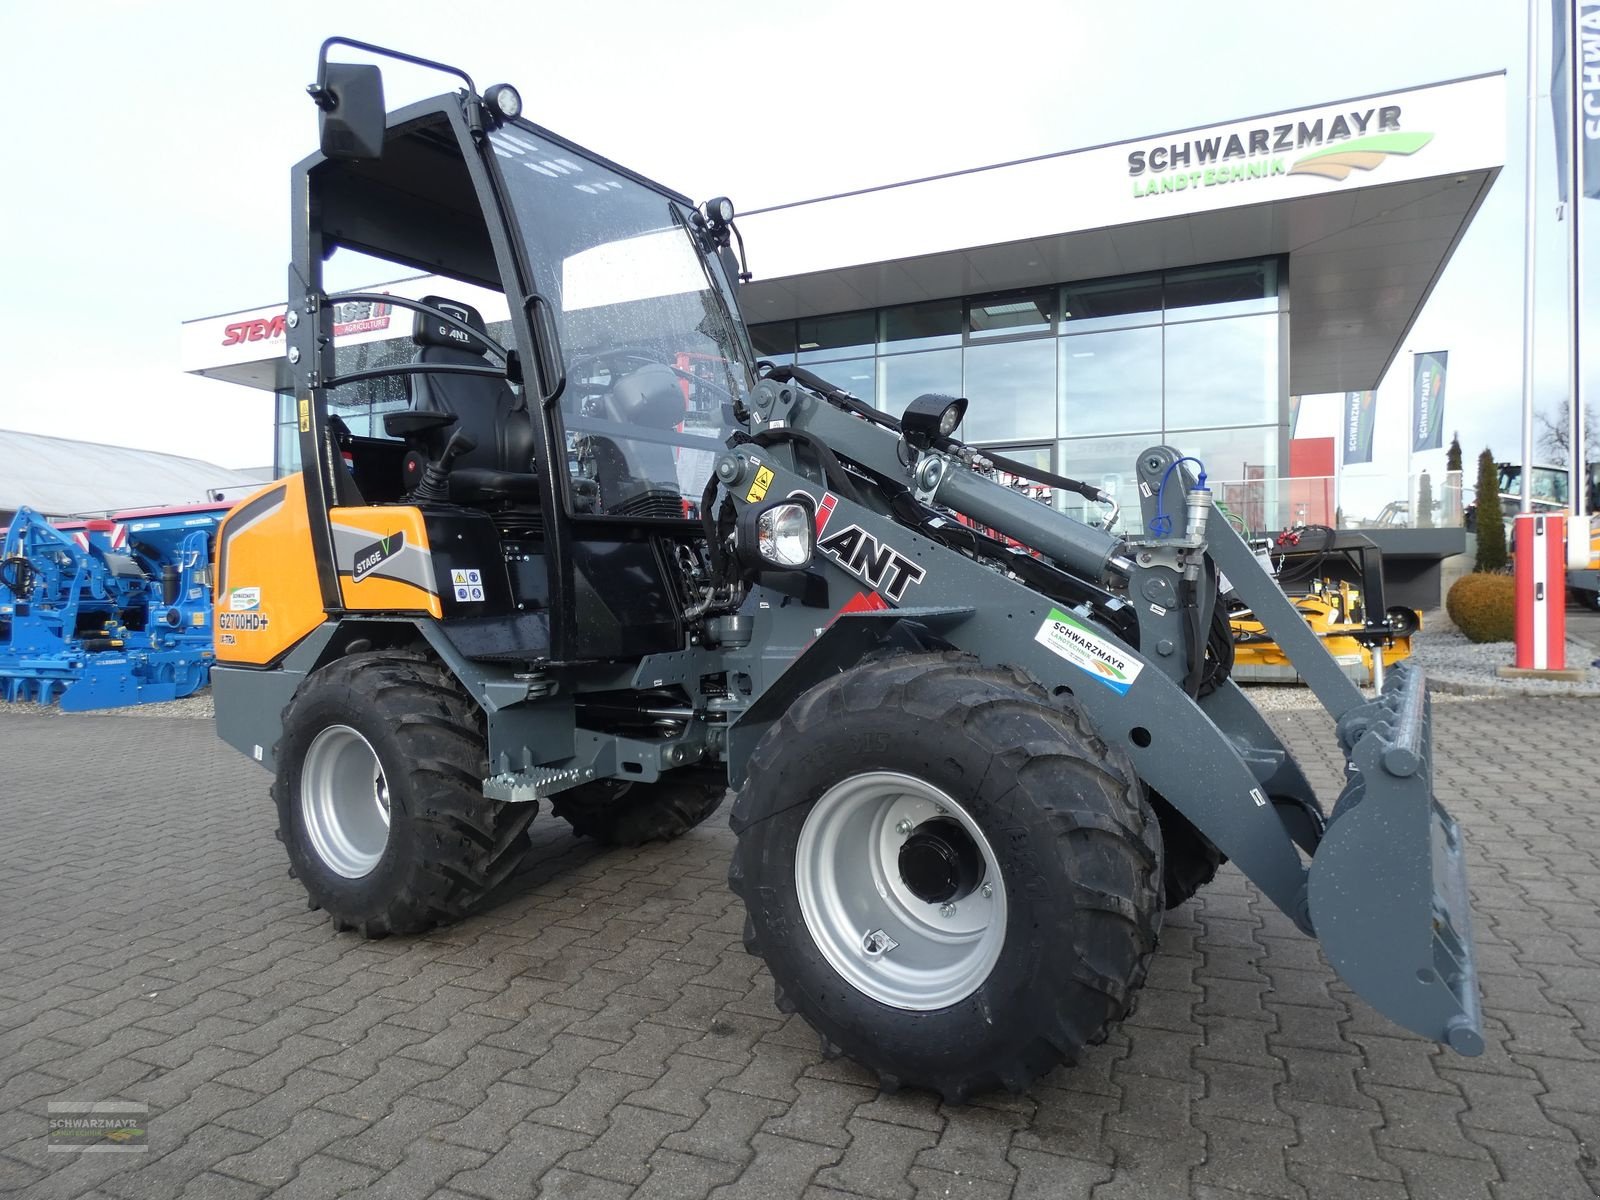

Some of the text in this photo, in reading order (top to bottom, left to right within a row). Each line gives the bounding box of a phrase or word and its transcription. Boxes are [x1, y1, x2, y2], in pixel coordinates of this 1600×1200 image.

[1581, 0, 1600, 140] SCHWA
[1128, 105, 1402, 176] SCHWARZMAYR
[1133, 156, 1287, 198] LANDTECHNIK
[344, 319, 386, 333] AGRICULTURE
[439, 326, 468, 341] GANT
[1419, 371, 1431, 439] SCHWARZMAYR
[356, 551, 382, 574] STAGE
[219, 613, 268, 631] G2700HD+
[1050, 631, 1092, 659] LANDTECHNIK
[1053, 622, 1125, 671] SCHWARZMAYR
